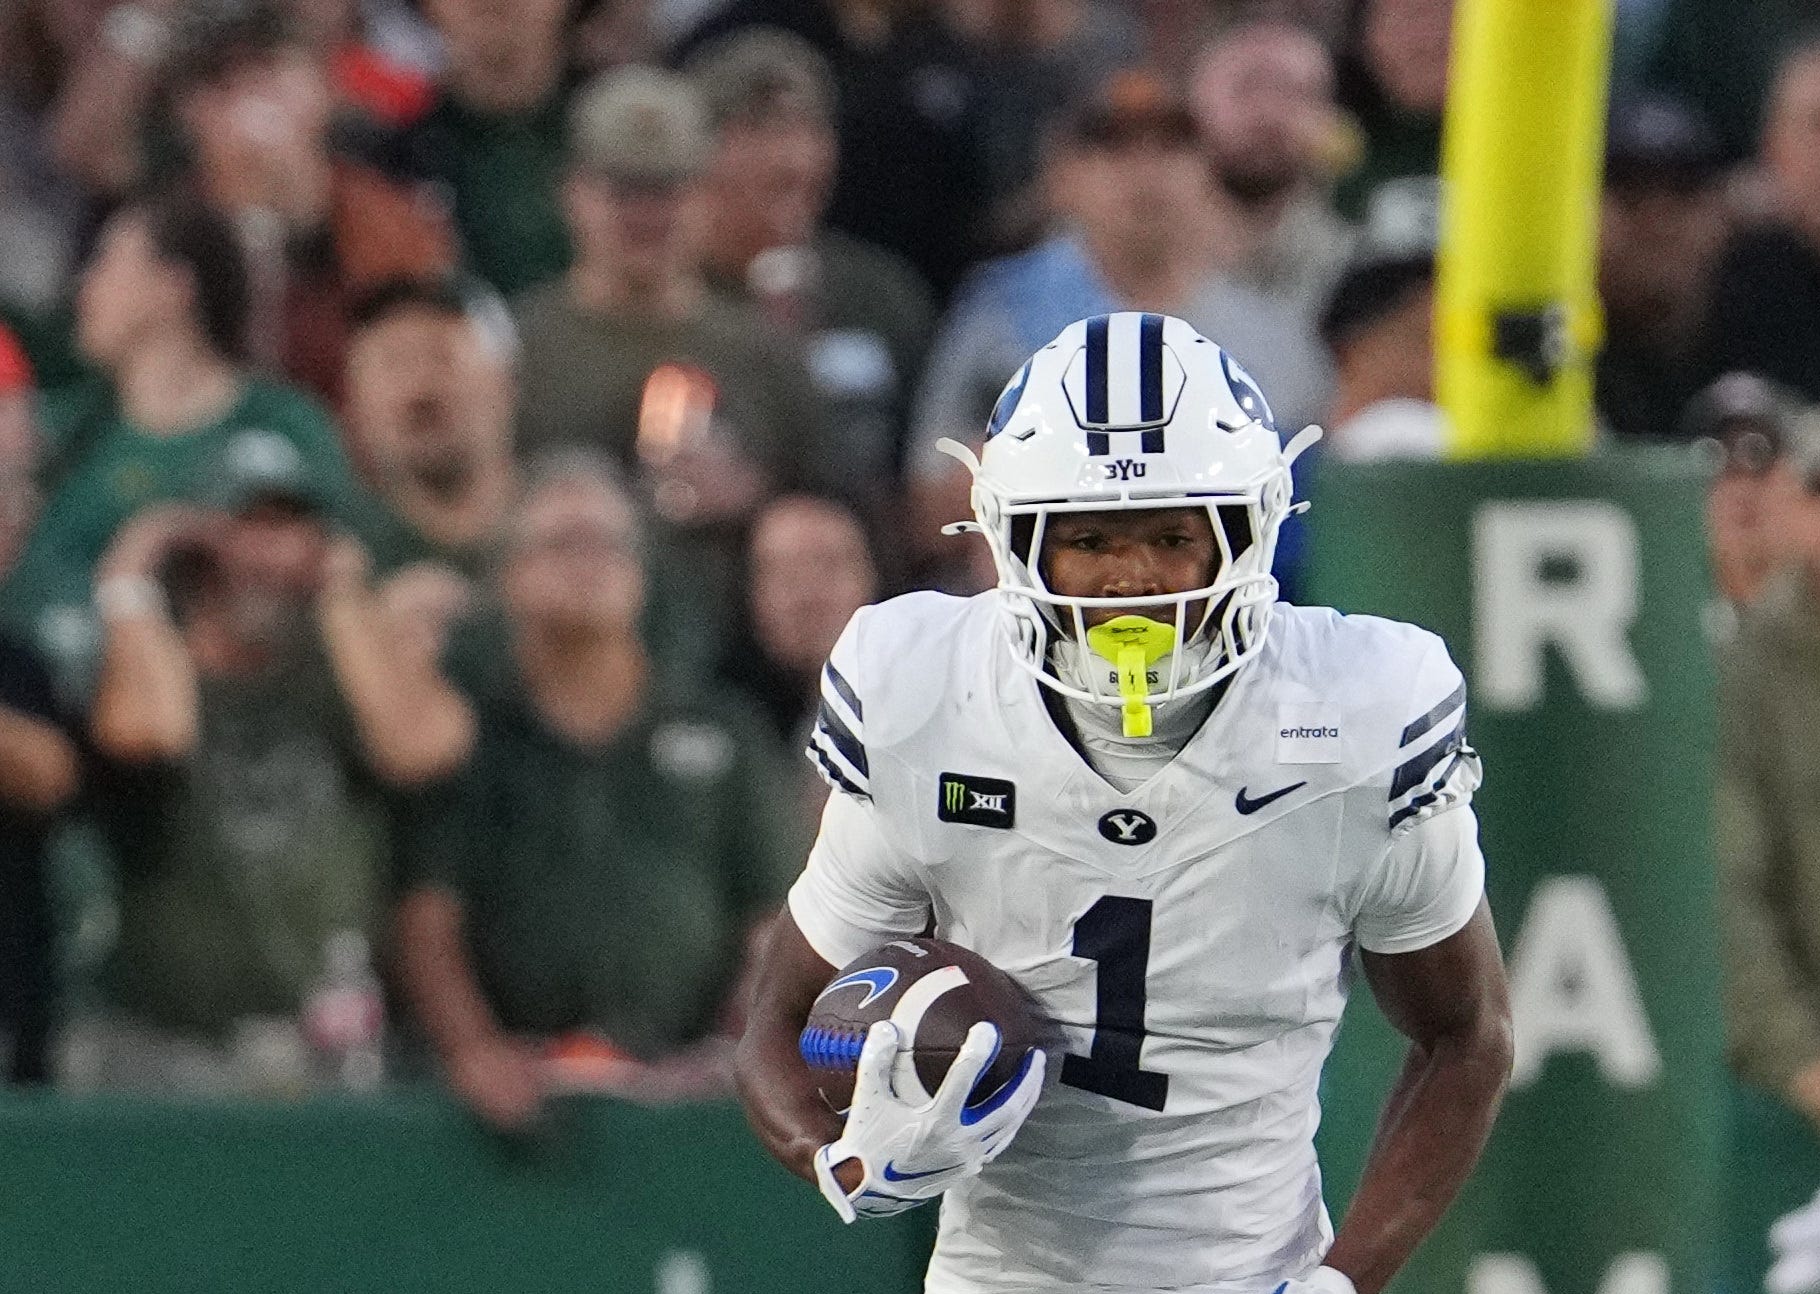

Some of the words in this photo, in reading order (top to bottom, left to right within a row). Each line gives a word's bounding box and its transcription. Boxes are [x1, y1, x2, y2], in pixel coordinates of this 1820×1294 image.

[1280, 725, 1338, 738] entrata
[1106, 813, 1148, 840] Y
[1059, 894, 1169, 1112] 1
